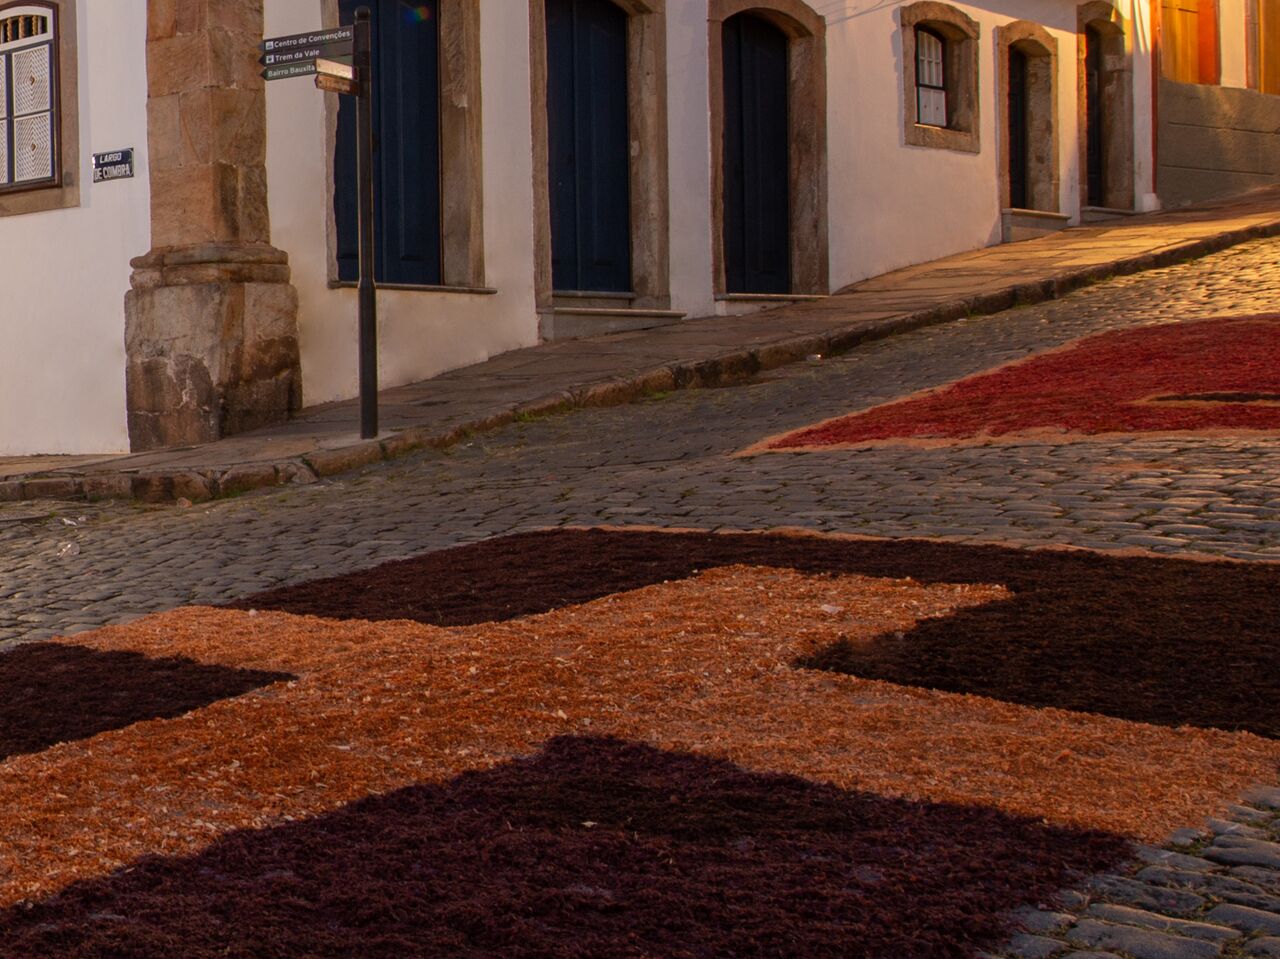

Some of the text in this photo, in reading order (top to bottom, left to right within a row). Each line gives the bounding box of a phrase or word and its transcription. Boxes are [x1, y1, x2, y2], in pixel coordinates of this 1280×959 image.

[274, 39, 297, 48] Centro
[308, 30, 350, 42] Convenções
[275, 53, 293, 61] Trem
[304, 49, 320, 57] Vale
[268, 68, 289, 77] Bairro
[100, 152, 122, 164] LARGO
[94, 163, 131, 180] DE COIMBRA
